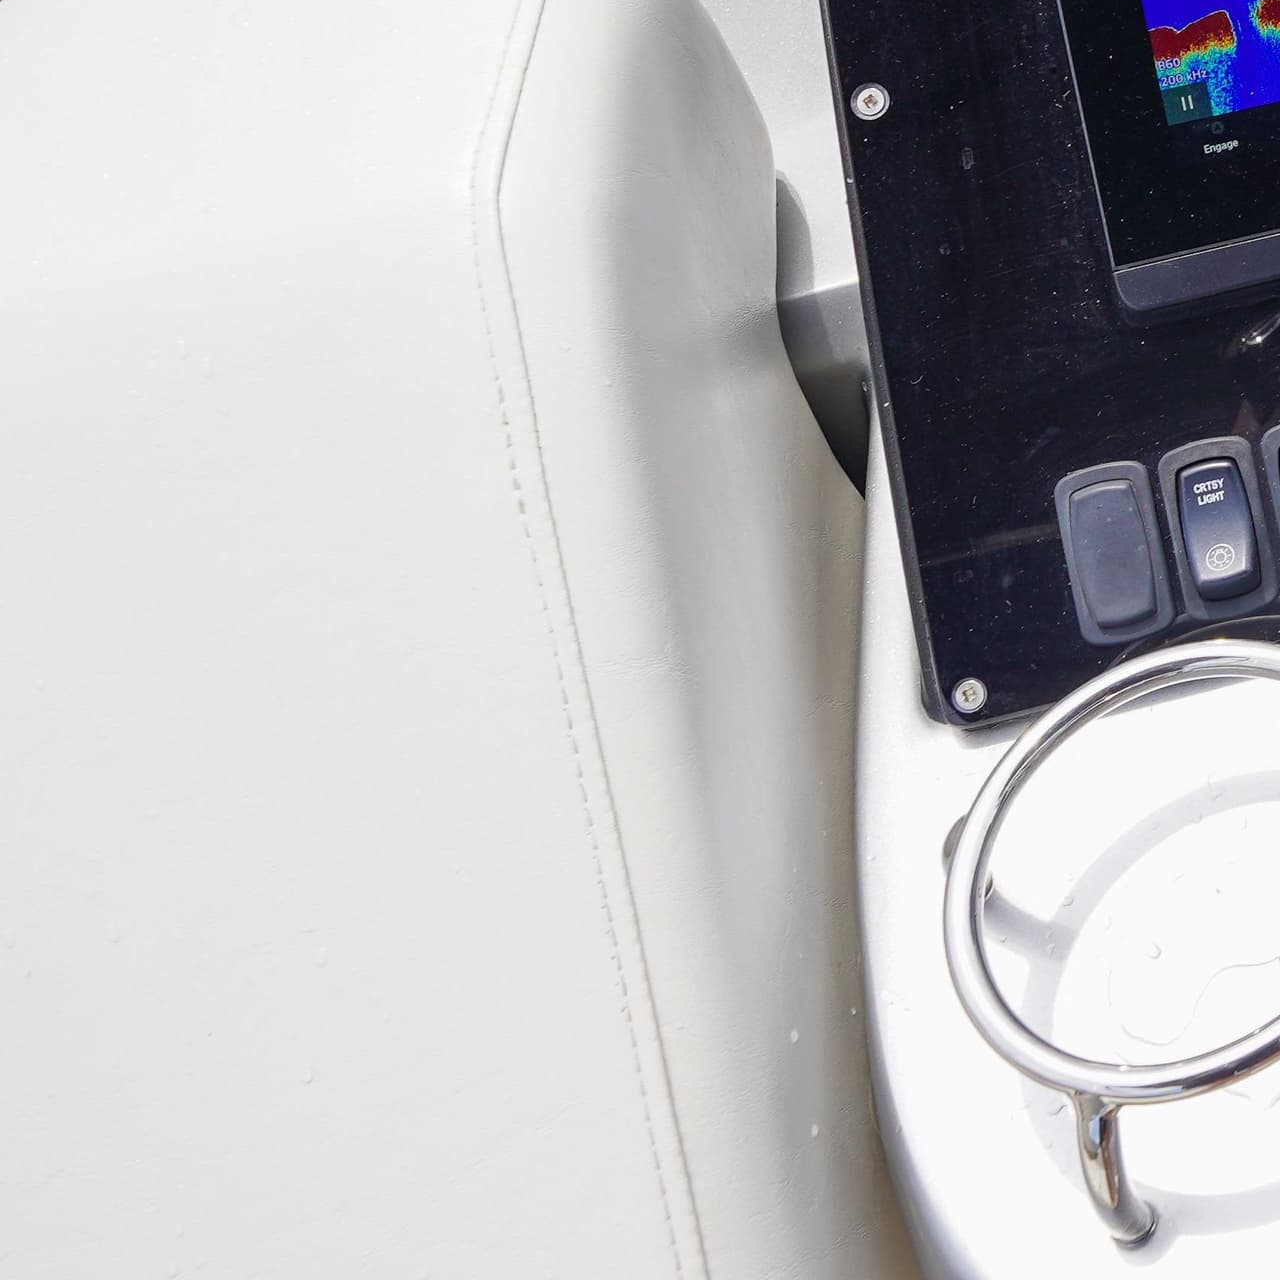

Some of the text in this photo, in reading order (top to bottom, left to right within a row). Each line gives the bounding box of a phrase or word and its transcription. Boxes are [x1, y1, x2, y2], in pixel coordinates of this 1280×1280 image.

[1161, 69, 1208, 87] 200 kHz
[1203, 138, 1239, 155] Engage
[1193, 477, 1225, 494] CRTSY
[1197, 491, 1225, 506] LIGHT
